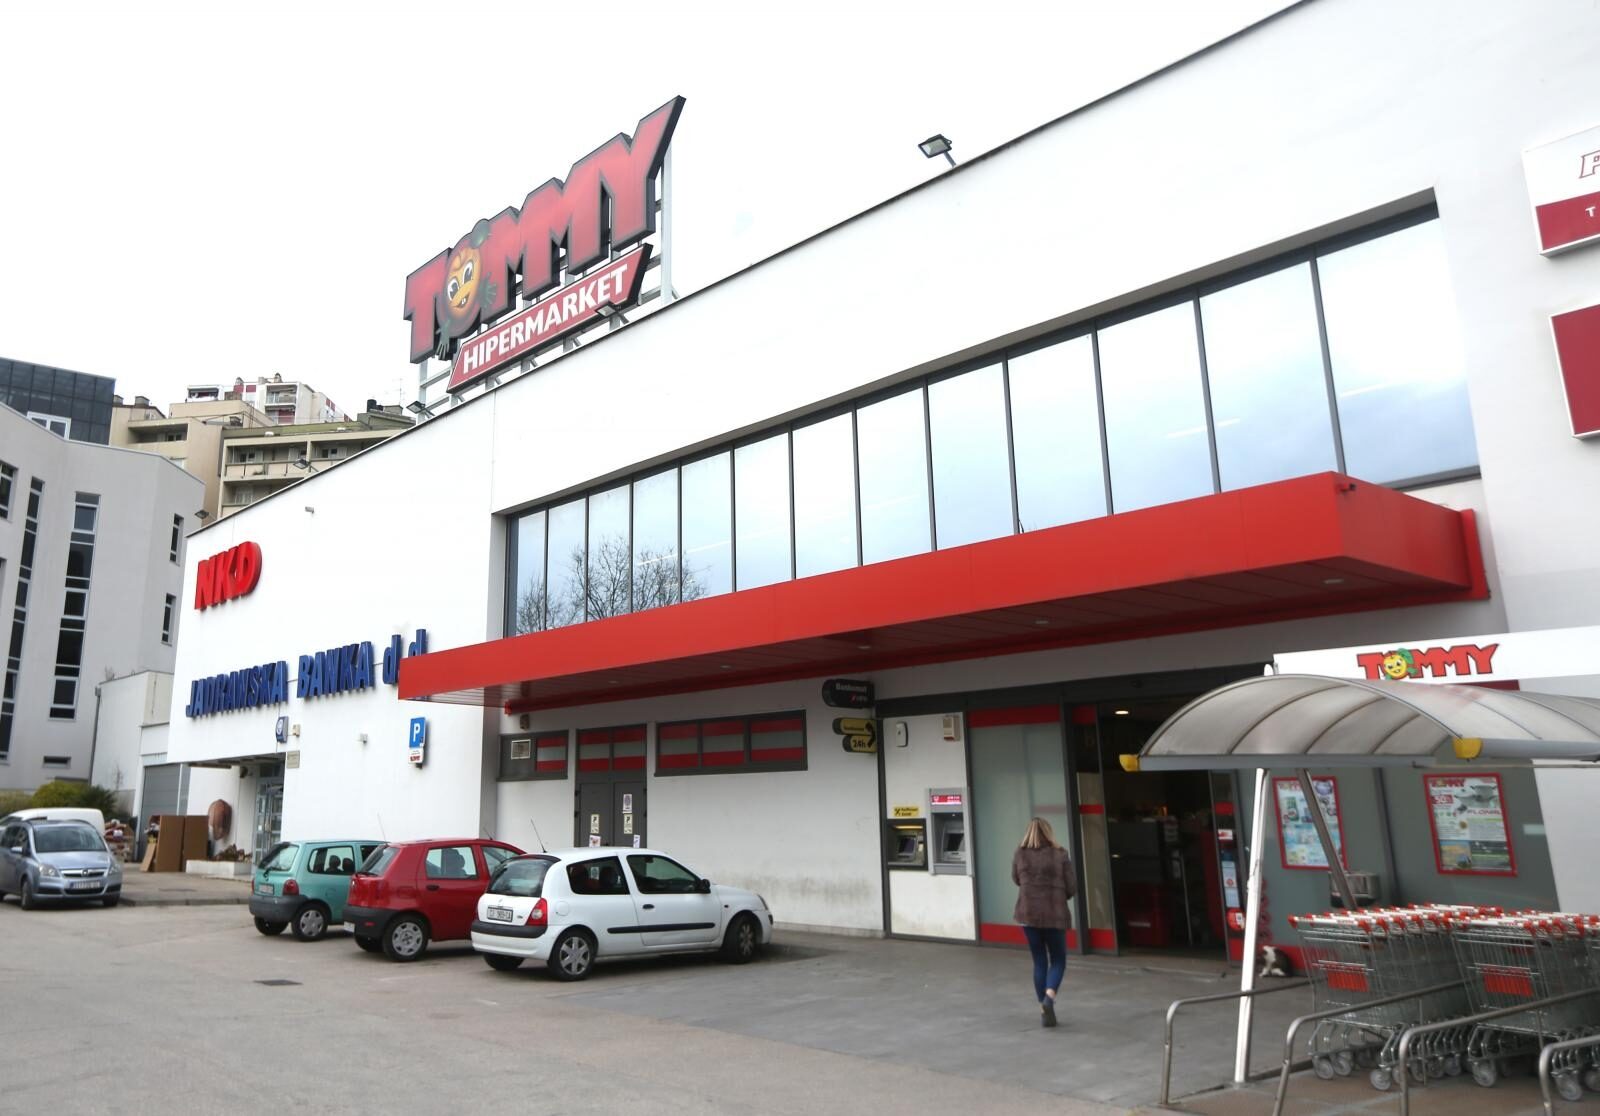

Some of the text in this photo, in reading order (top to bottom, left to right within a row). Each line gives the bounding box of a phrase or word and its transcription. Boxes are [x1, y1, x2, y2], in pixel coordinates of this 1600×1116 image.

[404, 95, 686, 363] TOMMY
[462, 264, 628, 374] HIPERMARKET
[194, 541, 263, 611] NKD
[185, 660, 289, 718] JADRANSKA
[297, 641, 375, 700] BANKA
[1356, 643, 1500, 680] TOMMY
